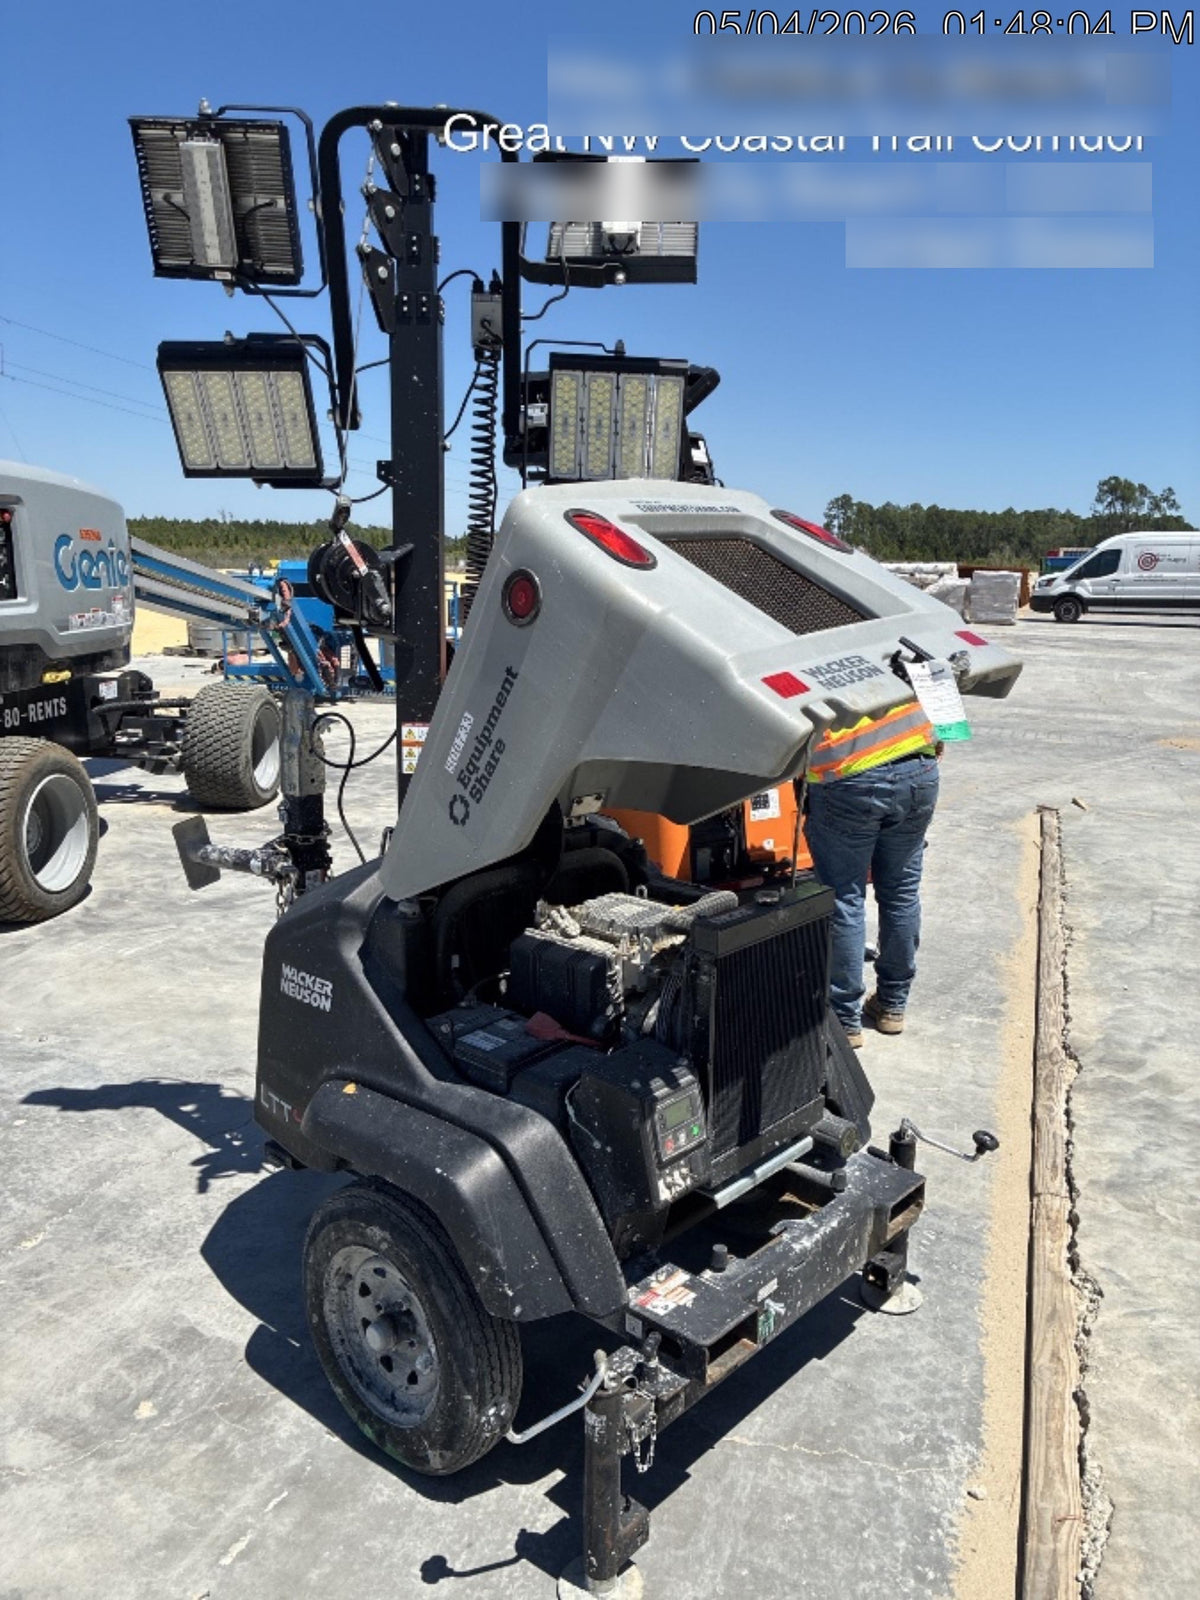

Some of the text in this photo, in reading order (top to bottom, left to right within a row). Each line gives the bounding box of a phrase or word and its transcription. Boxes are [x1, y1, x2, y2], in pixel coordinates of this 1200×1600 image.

[54, 533, 130, 592] Genie
[801, 655, 871, 678] WACKER
[818, 665, 886, 690] NEUSON
[456, 665, 519, 790] Equipment
[469, 738, 507, 804] Share
[281, 978, 332, 1012] NEUSON
[282, 962, 334, 998] WACKER
